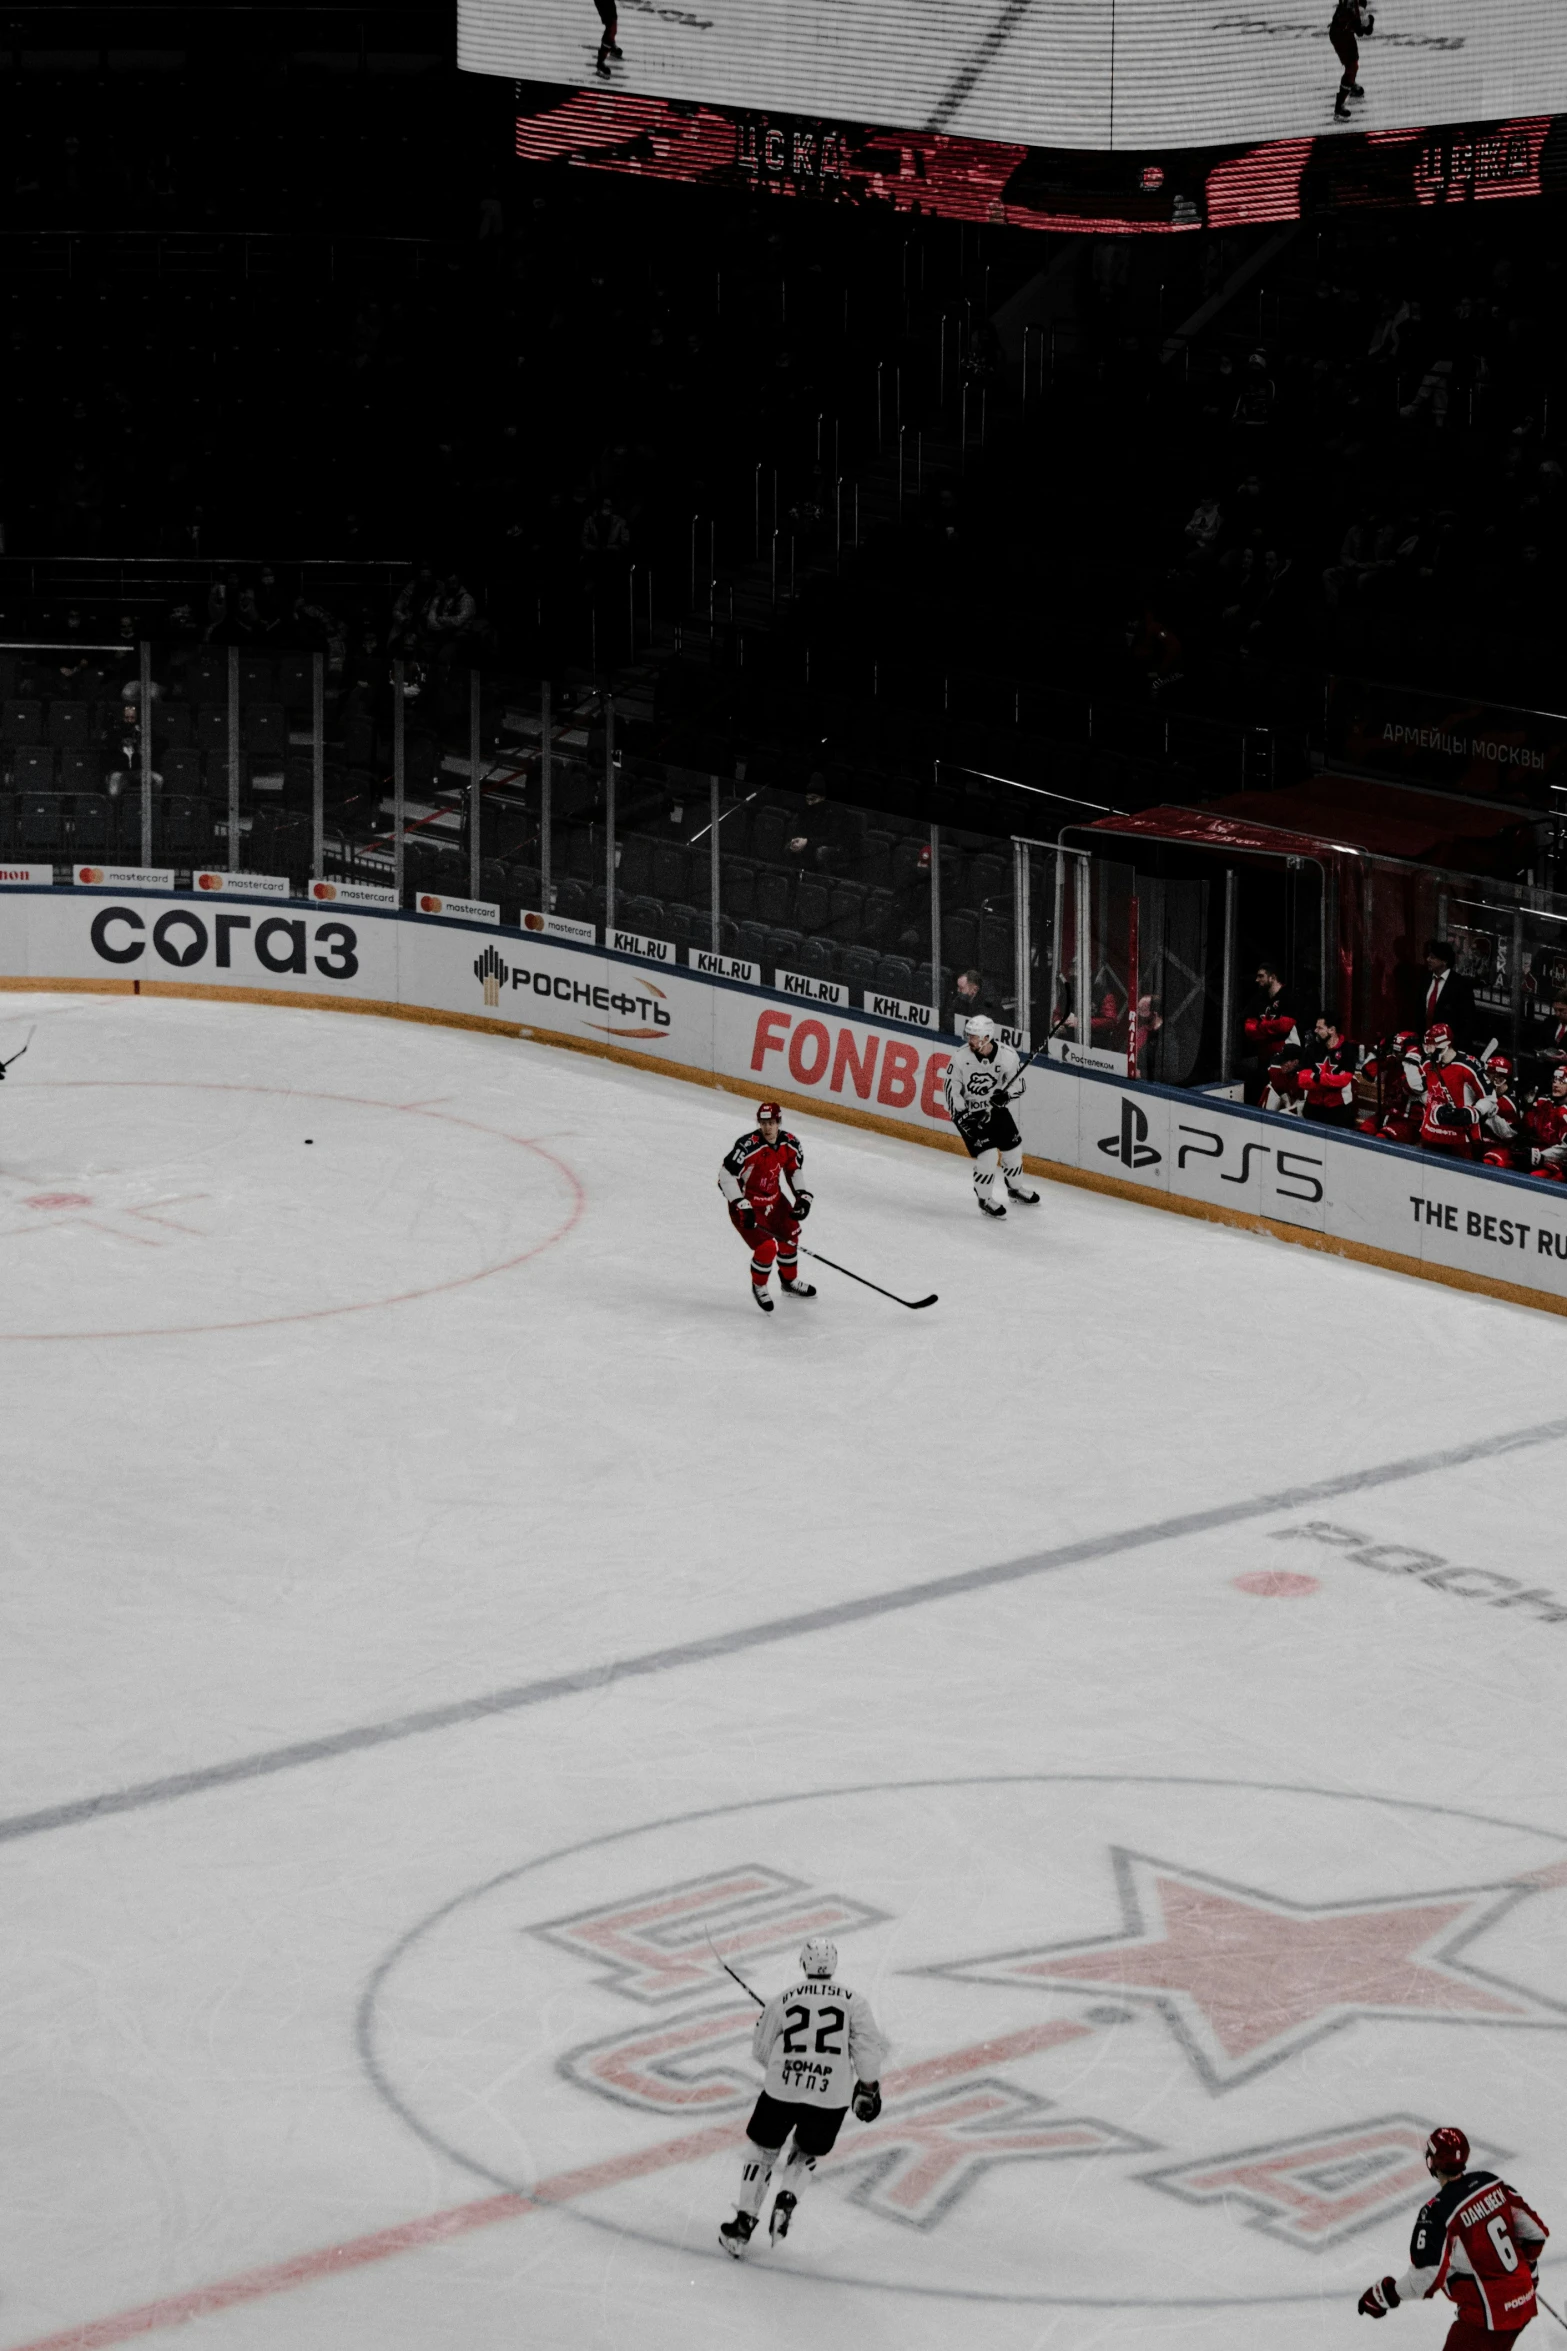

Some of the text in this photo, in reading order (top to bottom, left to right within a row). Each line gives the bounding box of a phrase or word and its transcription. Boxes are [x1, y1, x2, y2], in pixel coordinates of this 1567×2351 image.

[1383, 723, 1545, 770] АРМЕЙЦЫ МОСКВЫ
[109, 871, 169, 884] mastercard
[227, 877, 284, 892] mastercard
[340, 889, 395, 904] mastercard
[446, 902, 496, 918] mastercard
[548, 921, 592, 938] mastercard
[614, 932, 667, 961] KHL.RU
[698, 953, 752, 981] KHL.RU
[512, 968, 671, 1027] РОСНЕФТЬ
[784, 974, 840, 1003] KHL.RU
[873, 997, 930, 1026] KHL.RU
[1070, 1053, 1114, 1071] Ростелеком
[732, 1149, 746, 1165] 15
[1177, 1124, 1324, 1203] PS5
[1410, 1196, 1458, 1232] THE
[1466, 1210, 1530, 1250] BEST
[783, 2005, 845, 2056] 22
[1416, 2229, 1427, 2250] 6
[1487, 2215, 1519, 2273] 6
